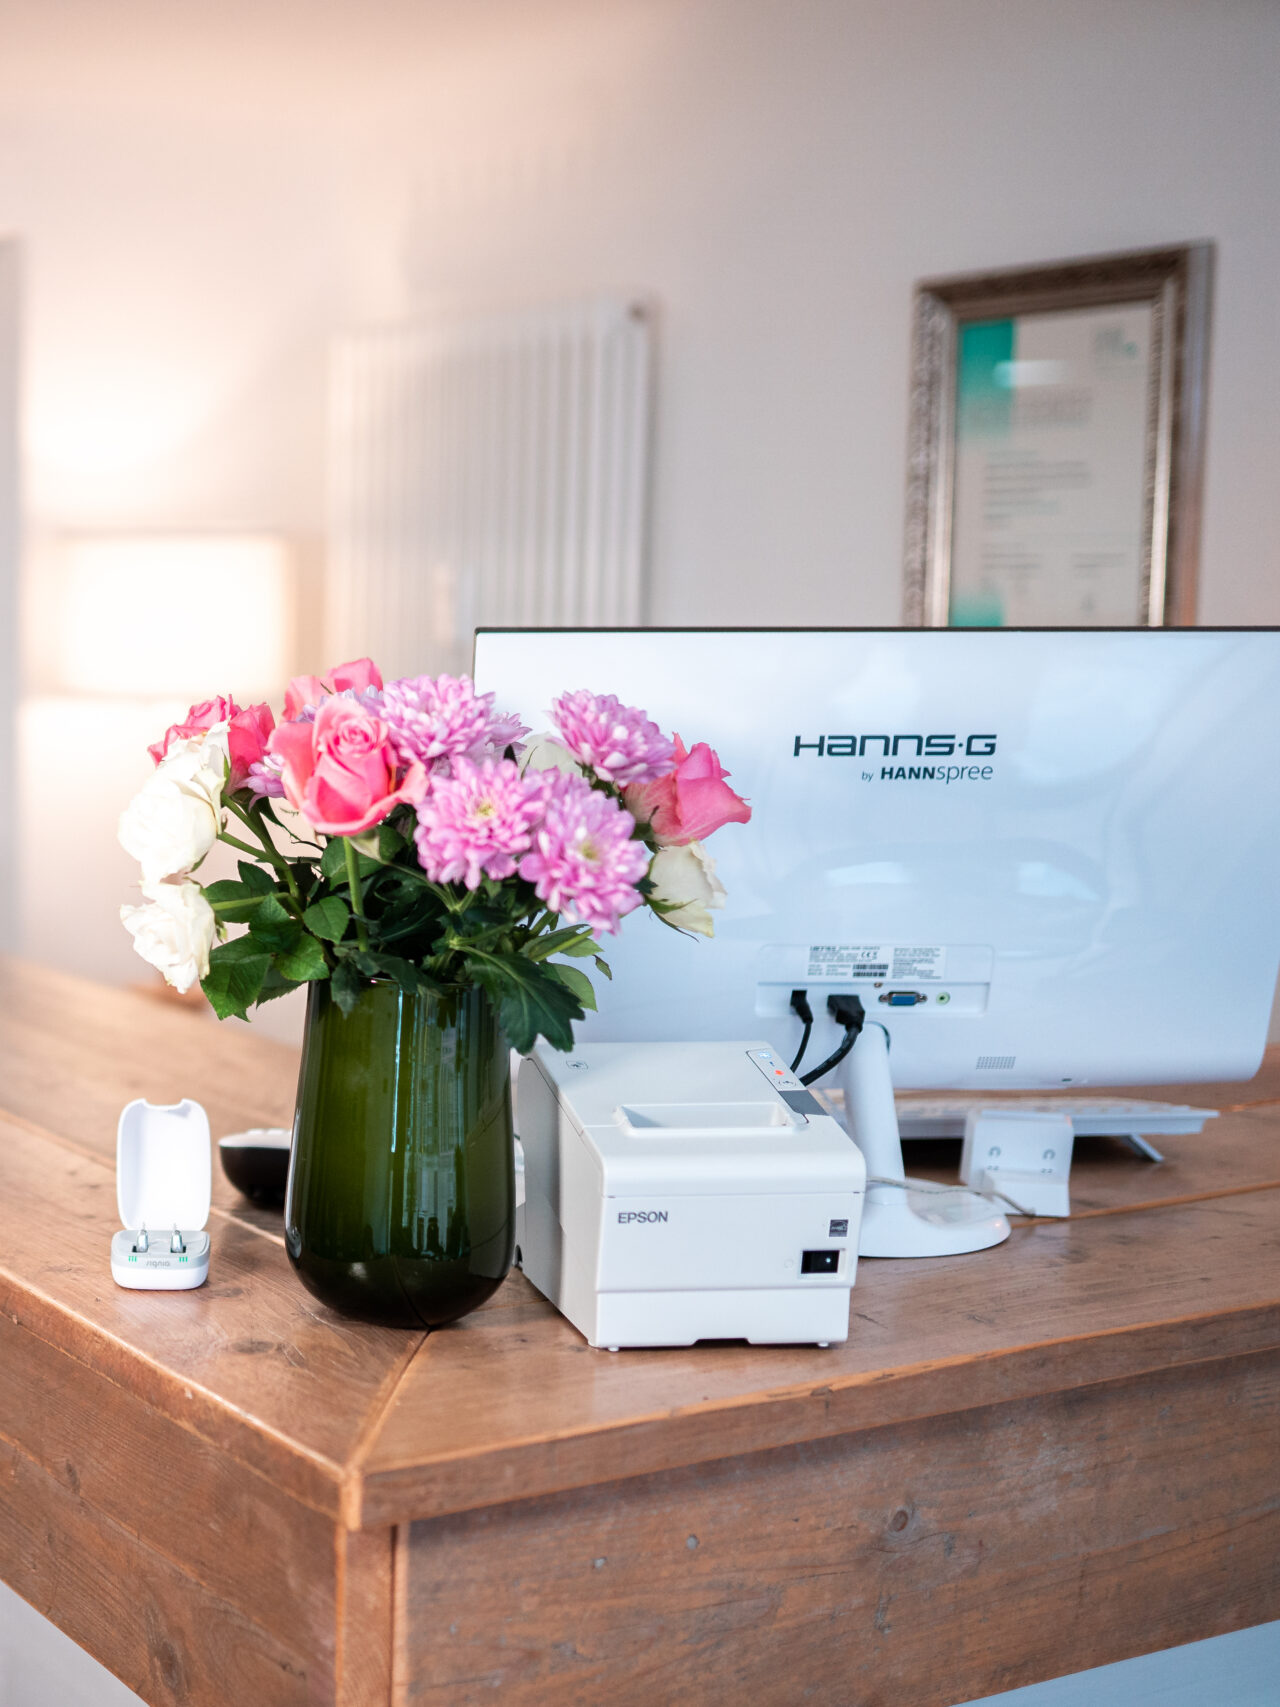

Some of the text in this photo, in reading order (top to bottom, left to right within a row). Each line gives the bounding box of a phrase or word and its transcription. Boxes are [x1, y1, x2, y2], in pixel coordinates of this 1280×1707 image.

[861, 765, 994, 785] by HANNspree
[617, 1210, 669, 1225] EPSON
